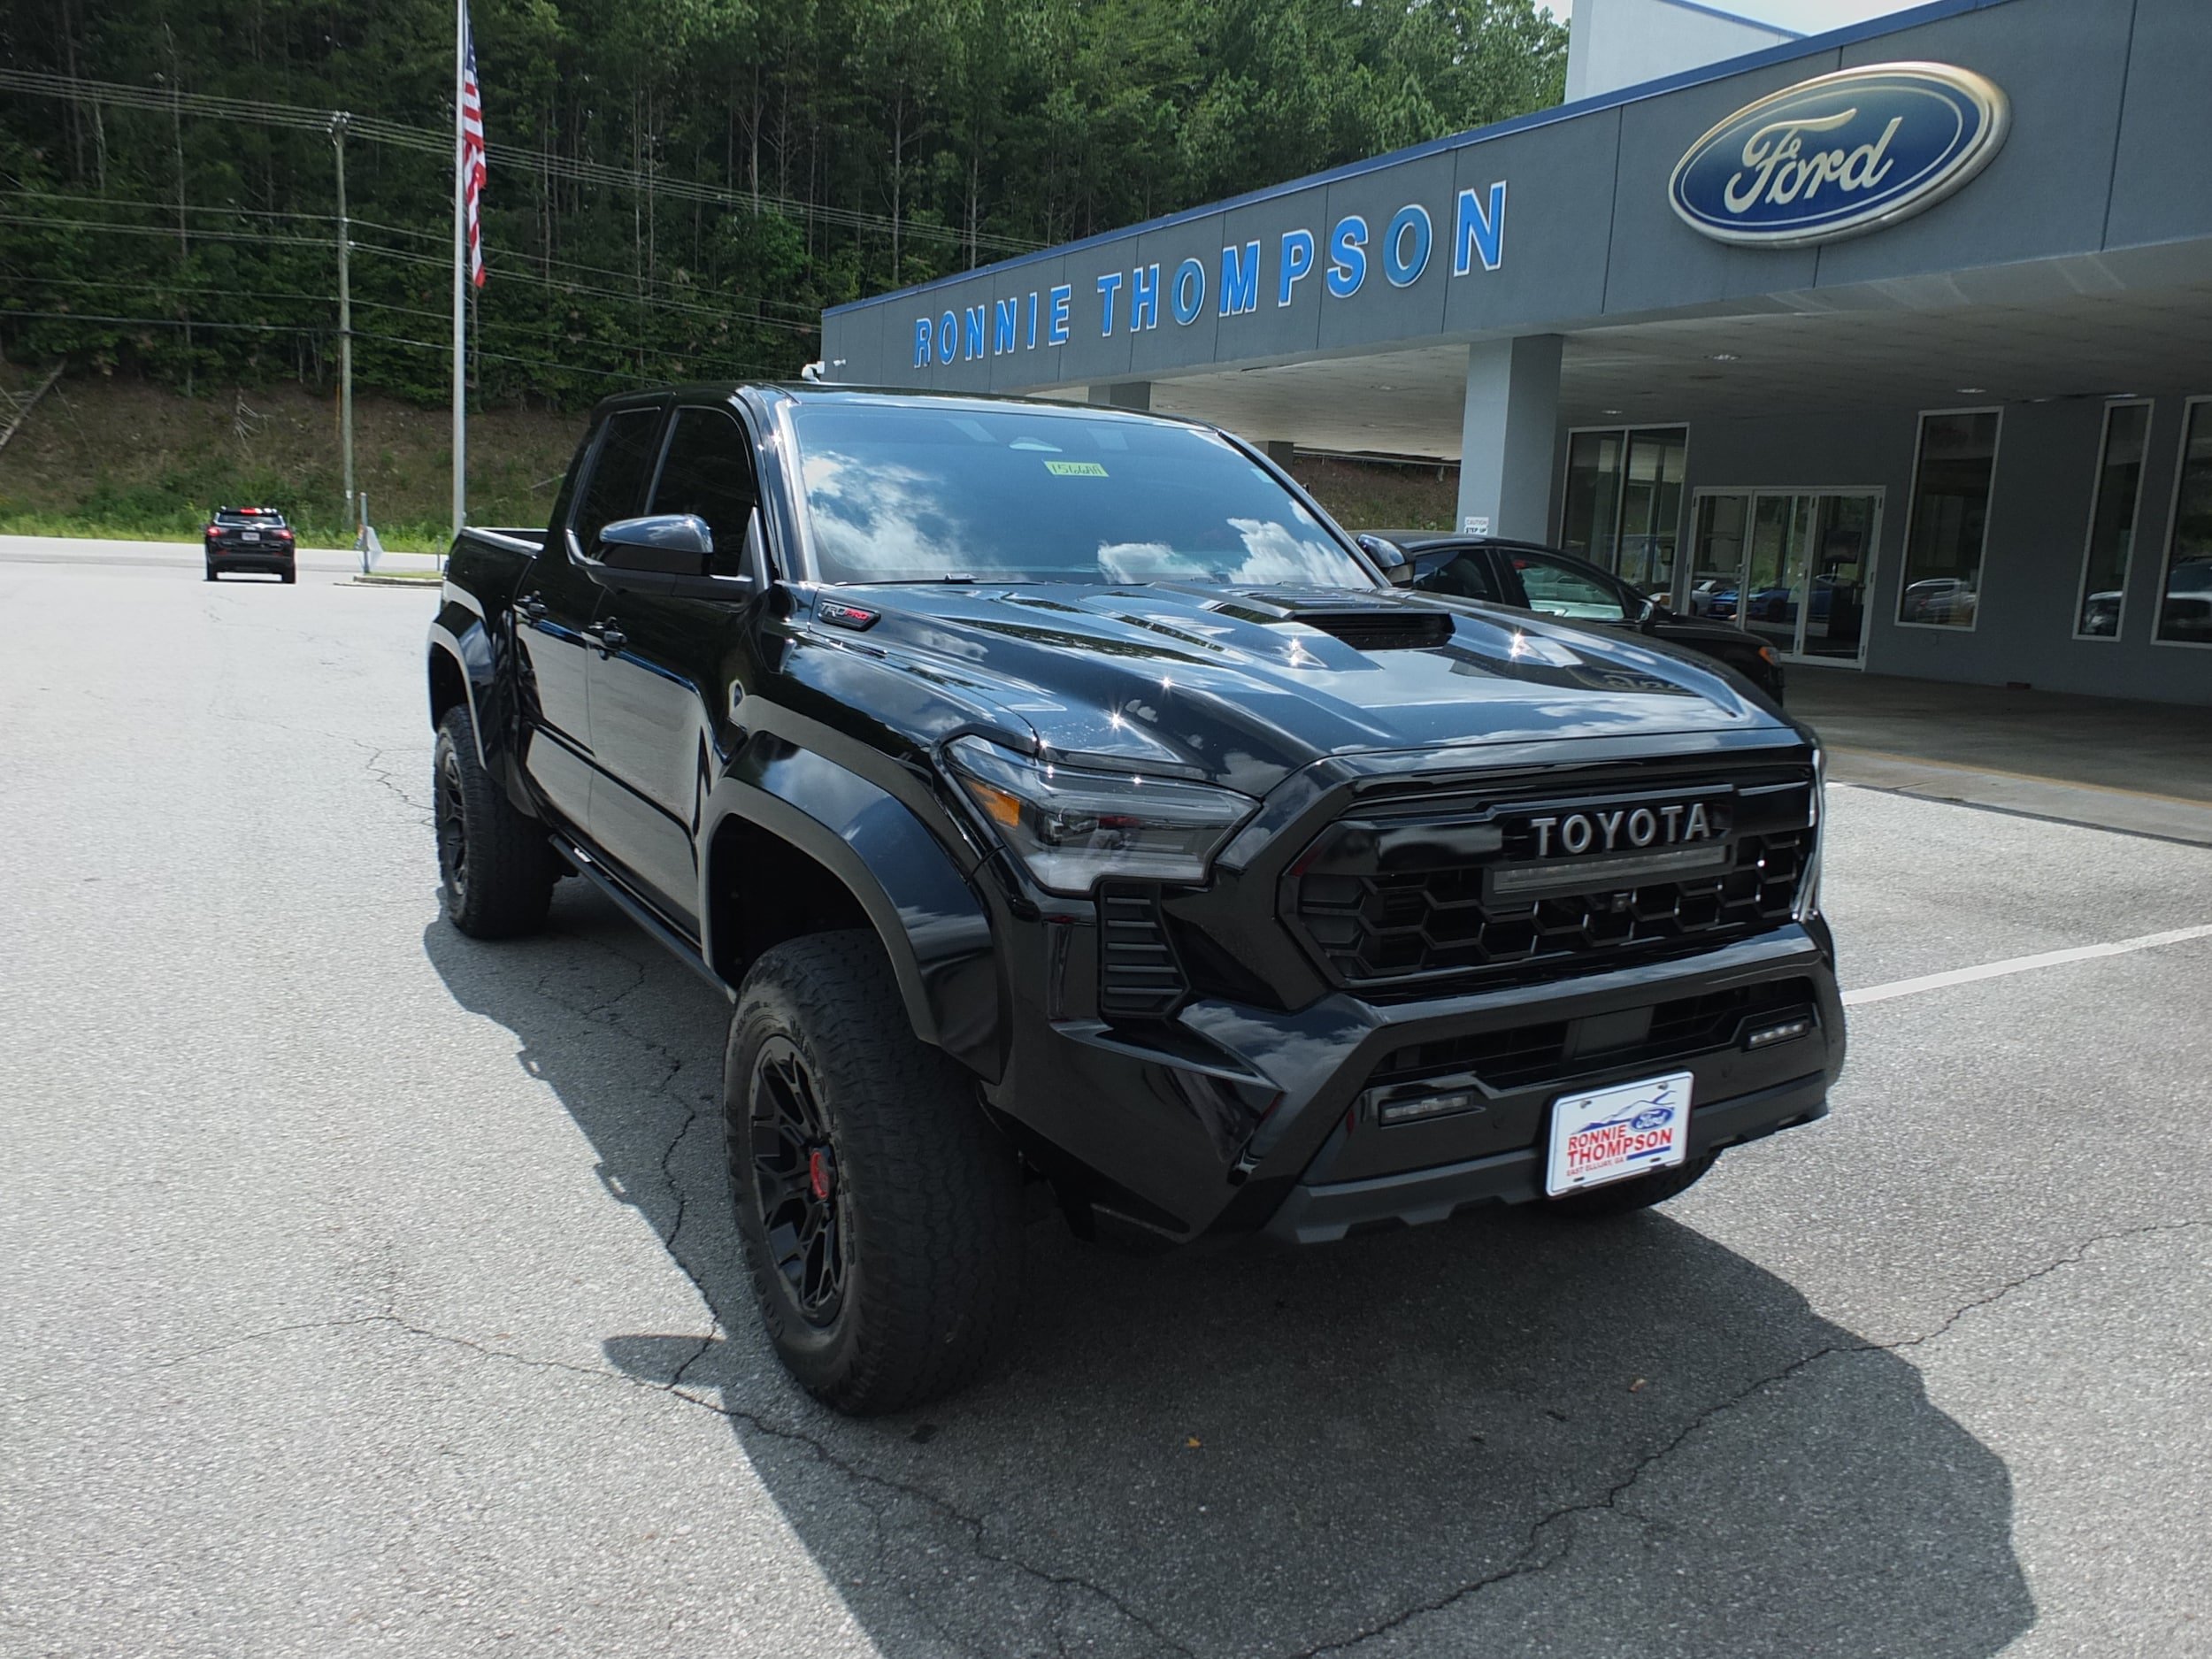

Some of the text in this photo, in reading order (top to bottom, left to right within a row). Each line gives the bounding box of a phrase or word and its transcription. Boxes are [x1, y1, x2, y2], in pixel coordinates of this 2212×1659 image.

[1724, 107, 1902, 213] Ford
[914, 180, 1506, 368] RONNIE THOMPSON
[821, 602, 847, 617] TRD
[1531, 803, 1711, 856] TOYOTA
[1568, 1125, 1627, 1150] RONNIE
[1637, 1110, 1669, 1129] Ford
[1567, 1128, 1672, 1167] THOMPSON
